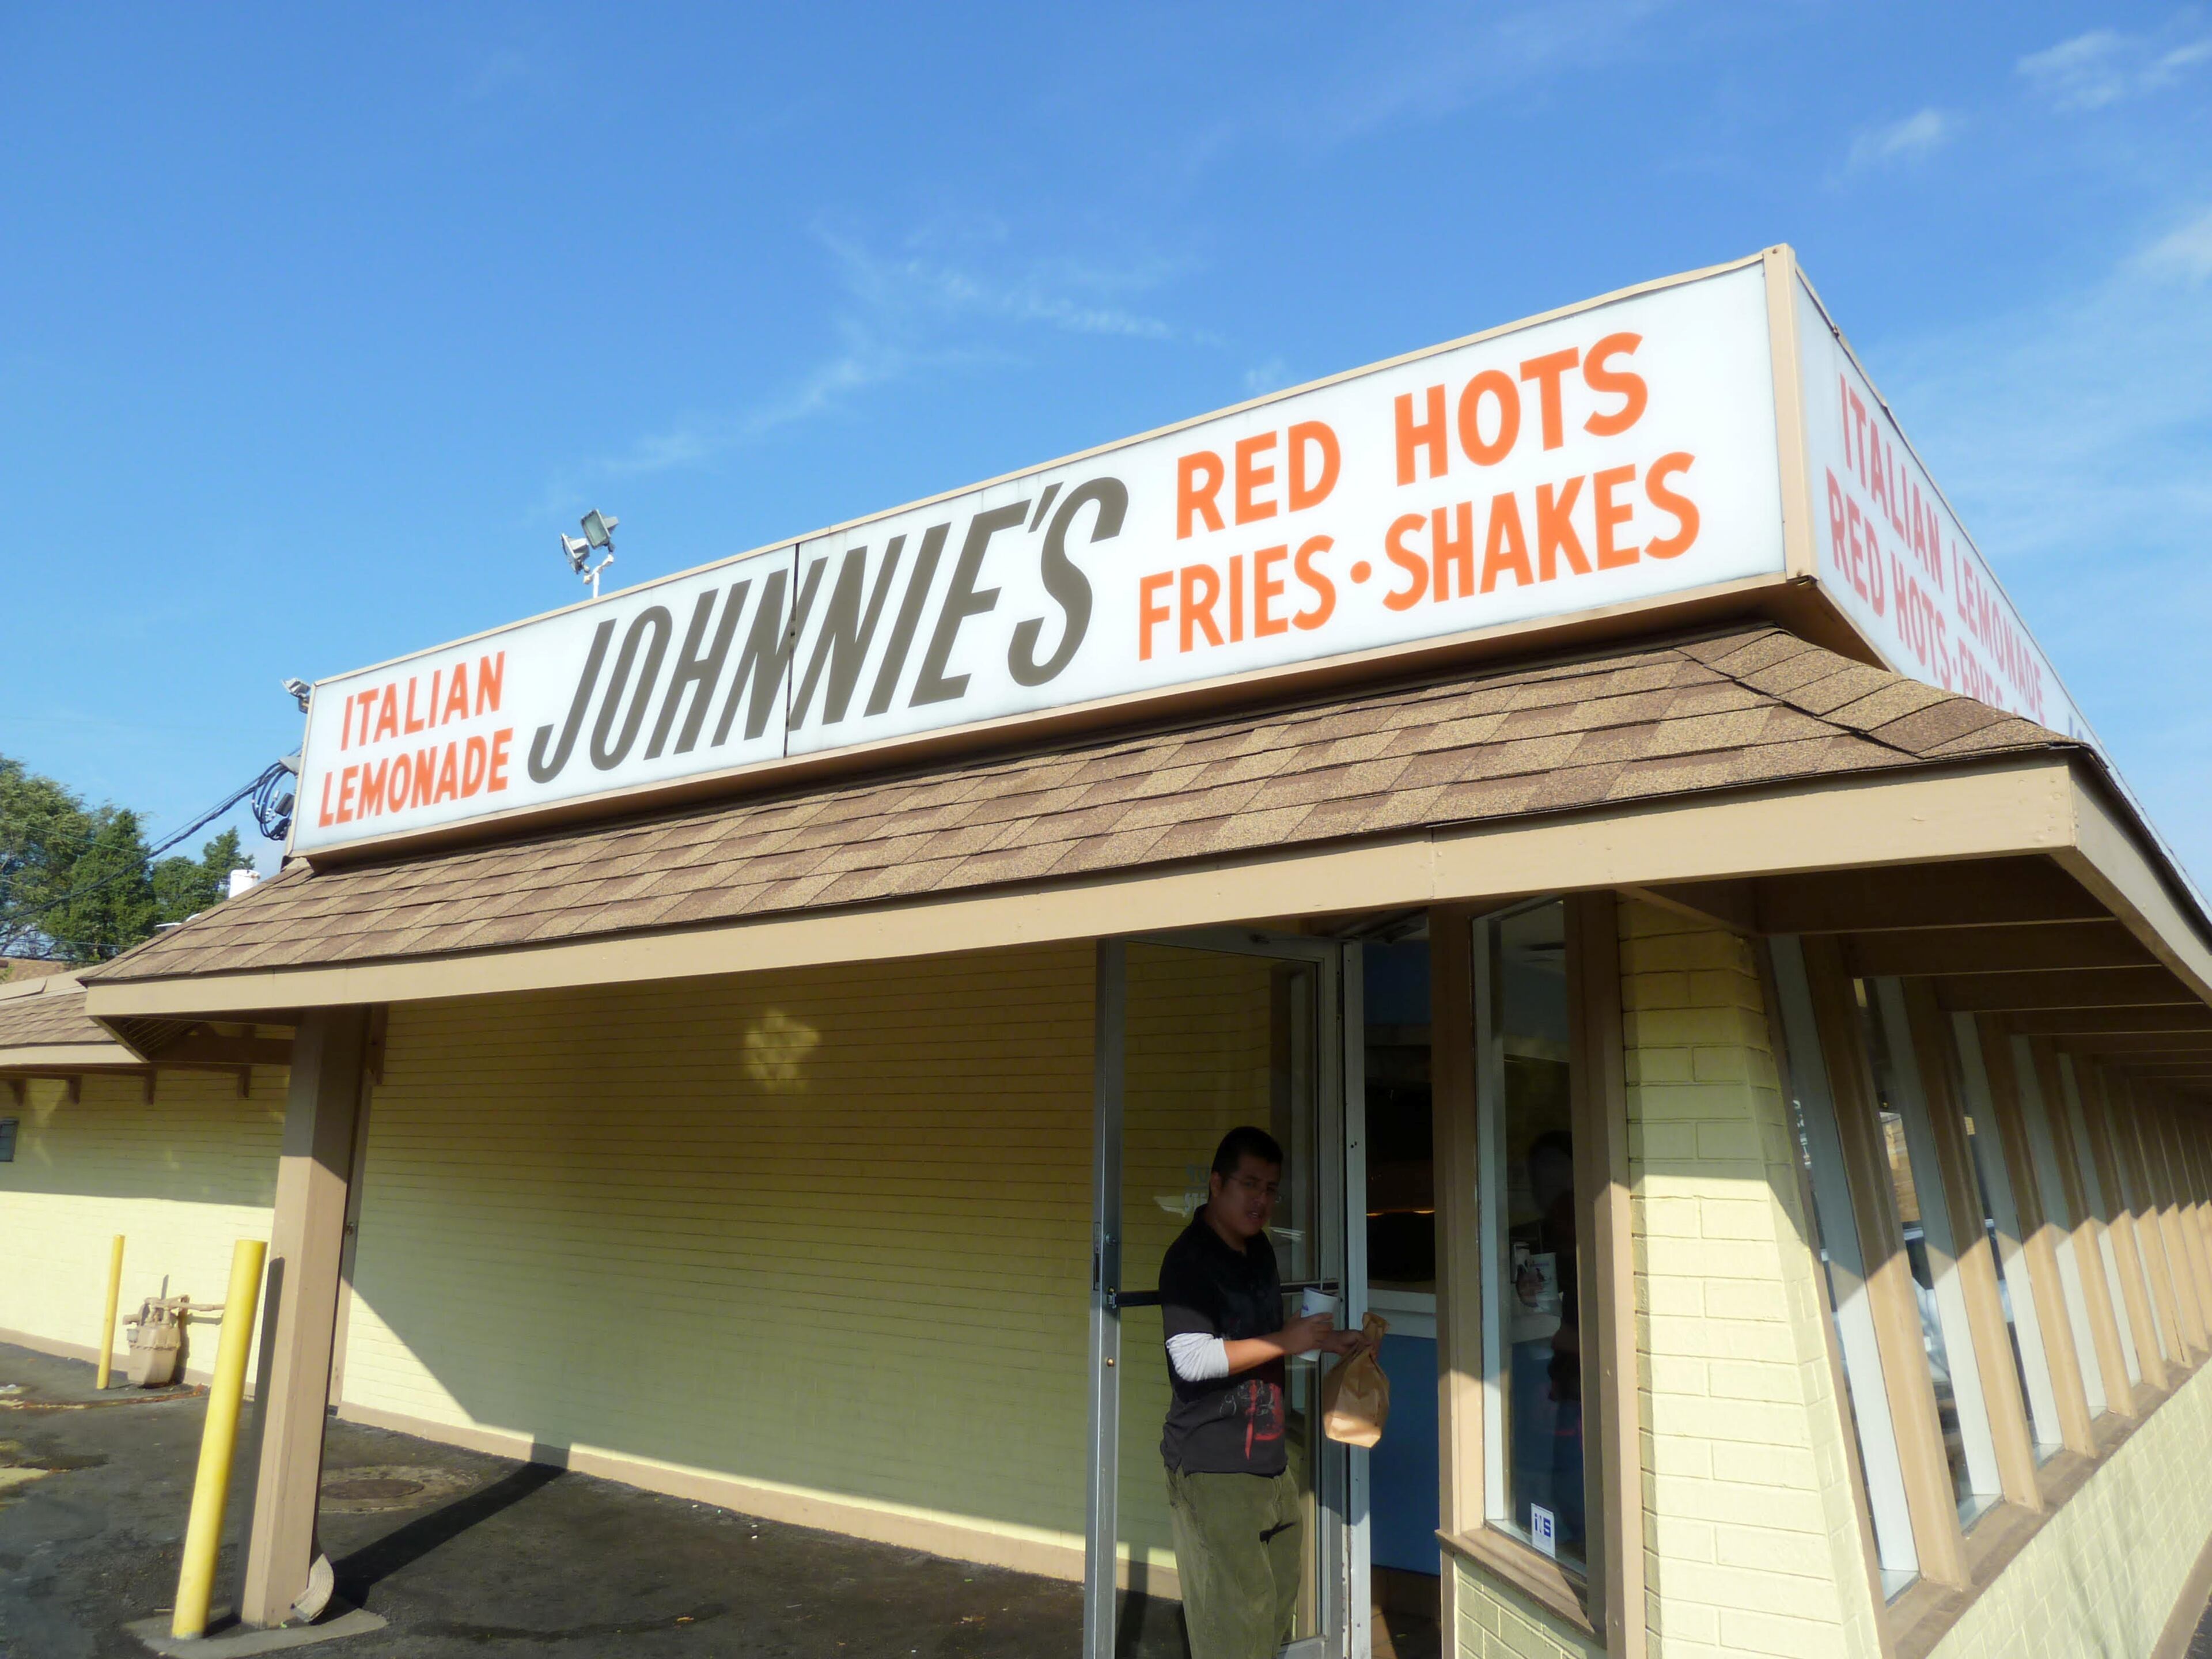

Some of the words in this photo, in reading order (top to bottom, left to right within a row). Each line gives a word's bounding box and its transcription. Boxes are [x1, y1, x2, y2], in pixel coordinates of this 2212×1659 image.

[1176, 420, 1341, 540] RED
[1394, 332, 1648, 486] HOTS
[528, 476, 1128, 784] JOHNNIE'S
[1139, 535, 1336, 661] FRIES
[1382, 451, 1700, 612] SHAKES
[1826, 465, 1885, 617] RED
[1890, 550, 1951, 692] HOTS
[1840, 373, 1944, 594] ITALIAN
[1952, 539, 2046, 728] LEMONADE
[319, 728, 513, 828] LEMONADE
[341, 652, 505, 751] ITALIAN
